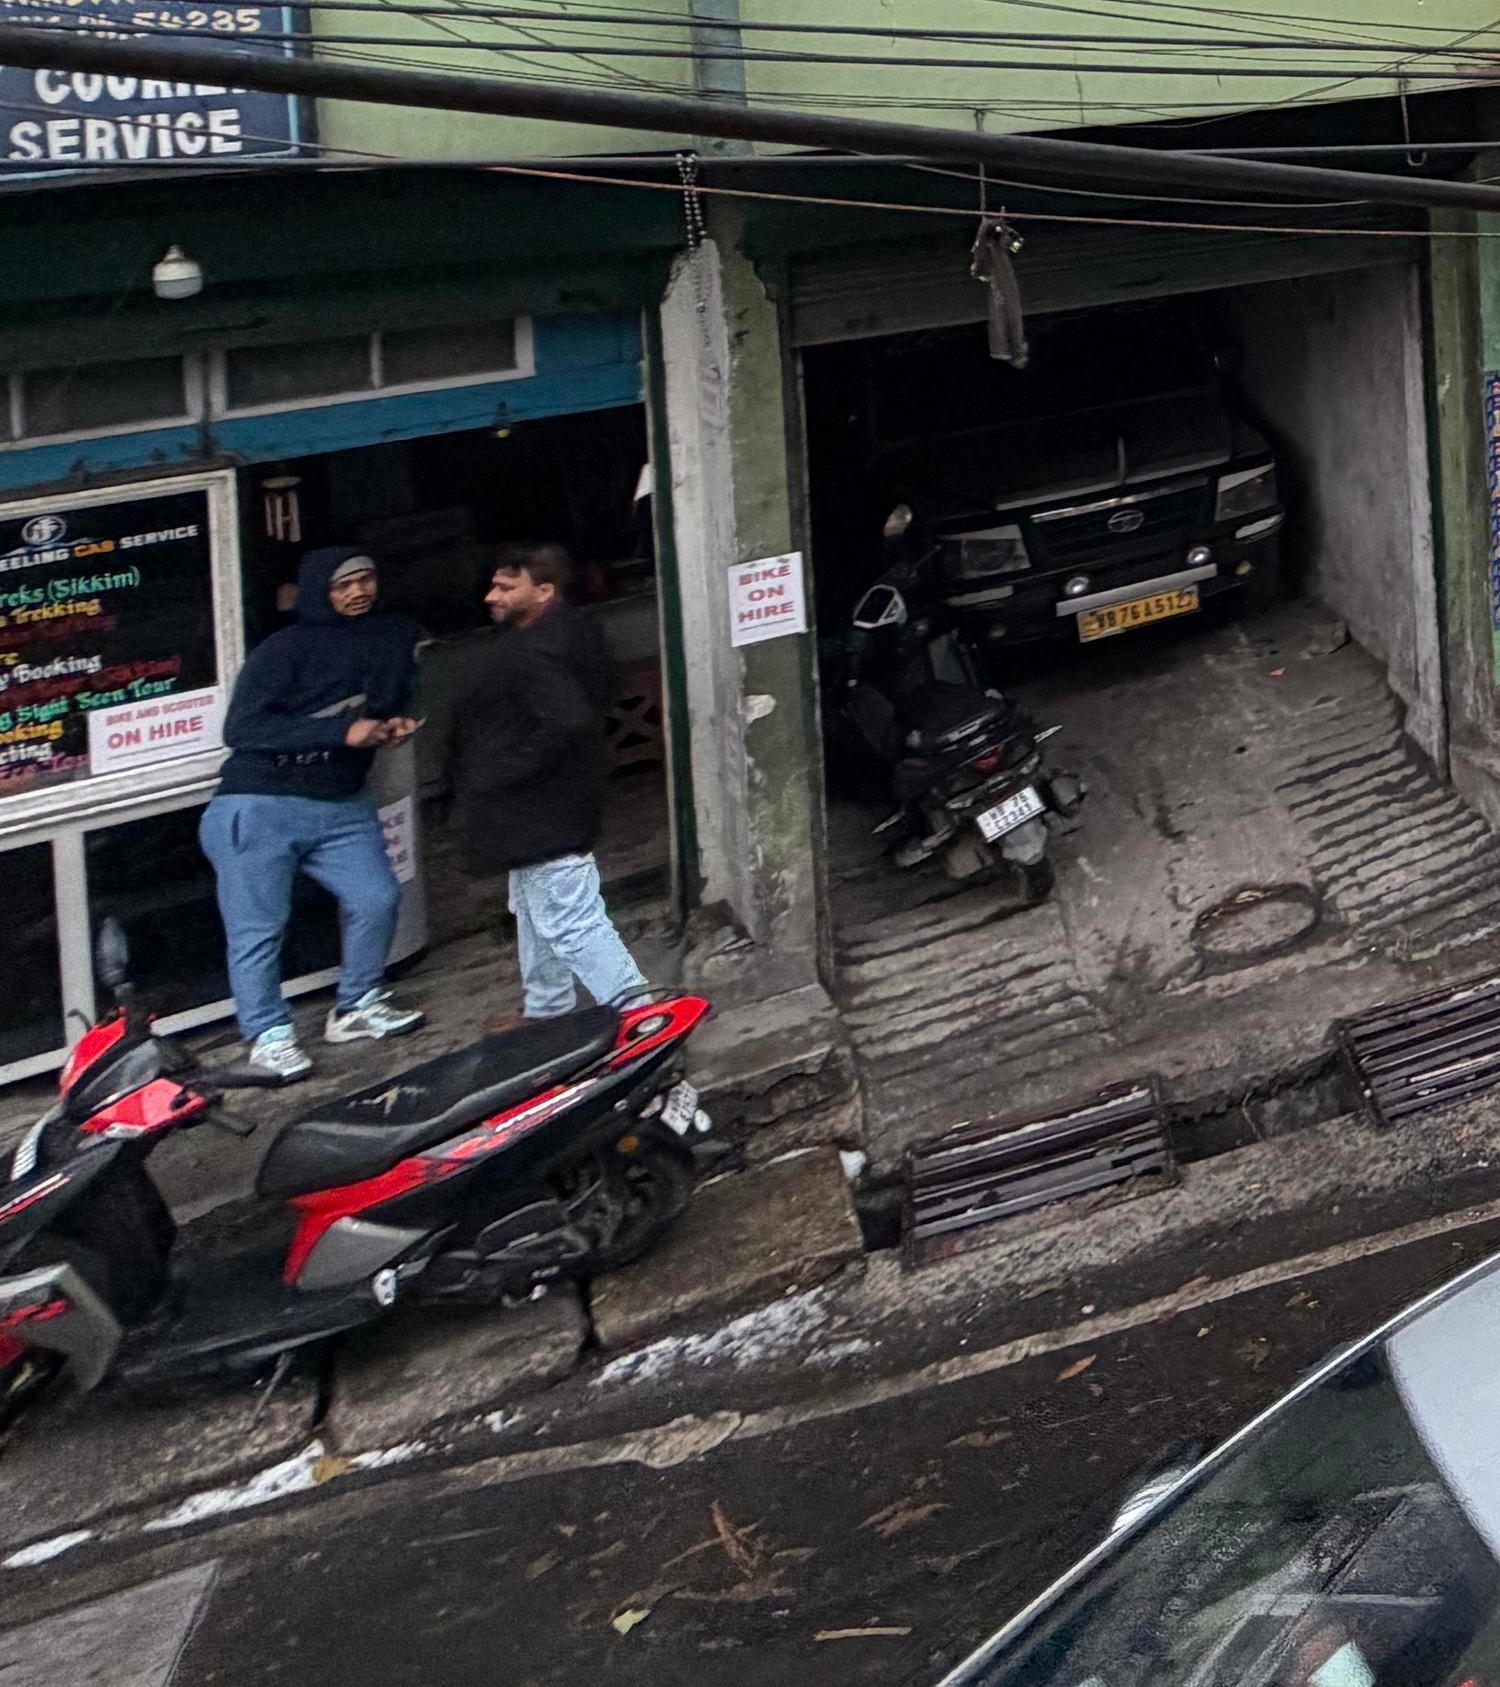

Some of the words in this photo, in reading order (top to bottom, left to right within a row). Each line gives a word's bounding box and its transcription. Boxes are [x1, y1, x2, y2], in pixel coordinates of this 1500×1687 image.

[34, 69, 248, 104] COUR
[8, 108, 243, 160] SERVICE
[119, 523, 200, 550] SERVICE
[739, 565, 792, 586] BIKE
[747, 584, 785, 602] ON
[738, 601, 795, 624] HIRE
[107, 728, 142, 749] ON
[149, 716, 203, 741] HIRE
